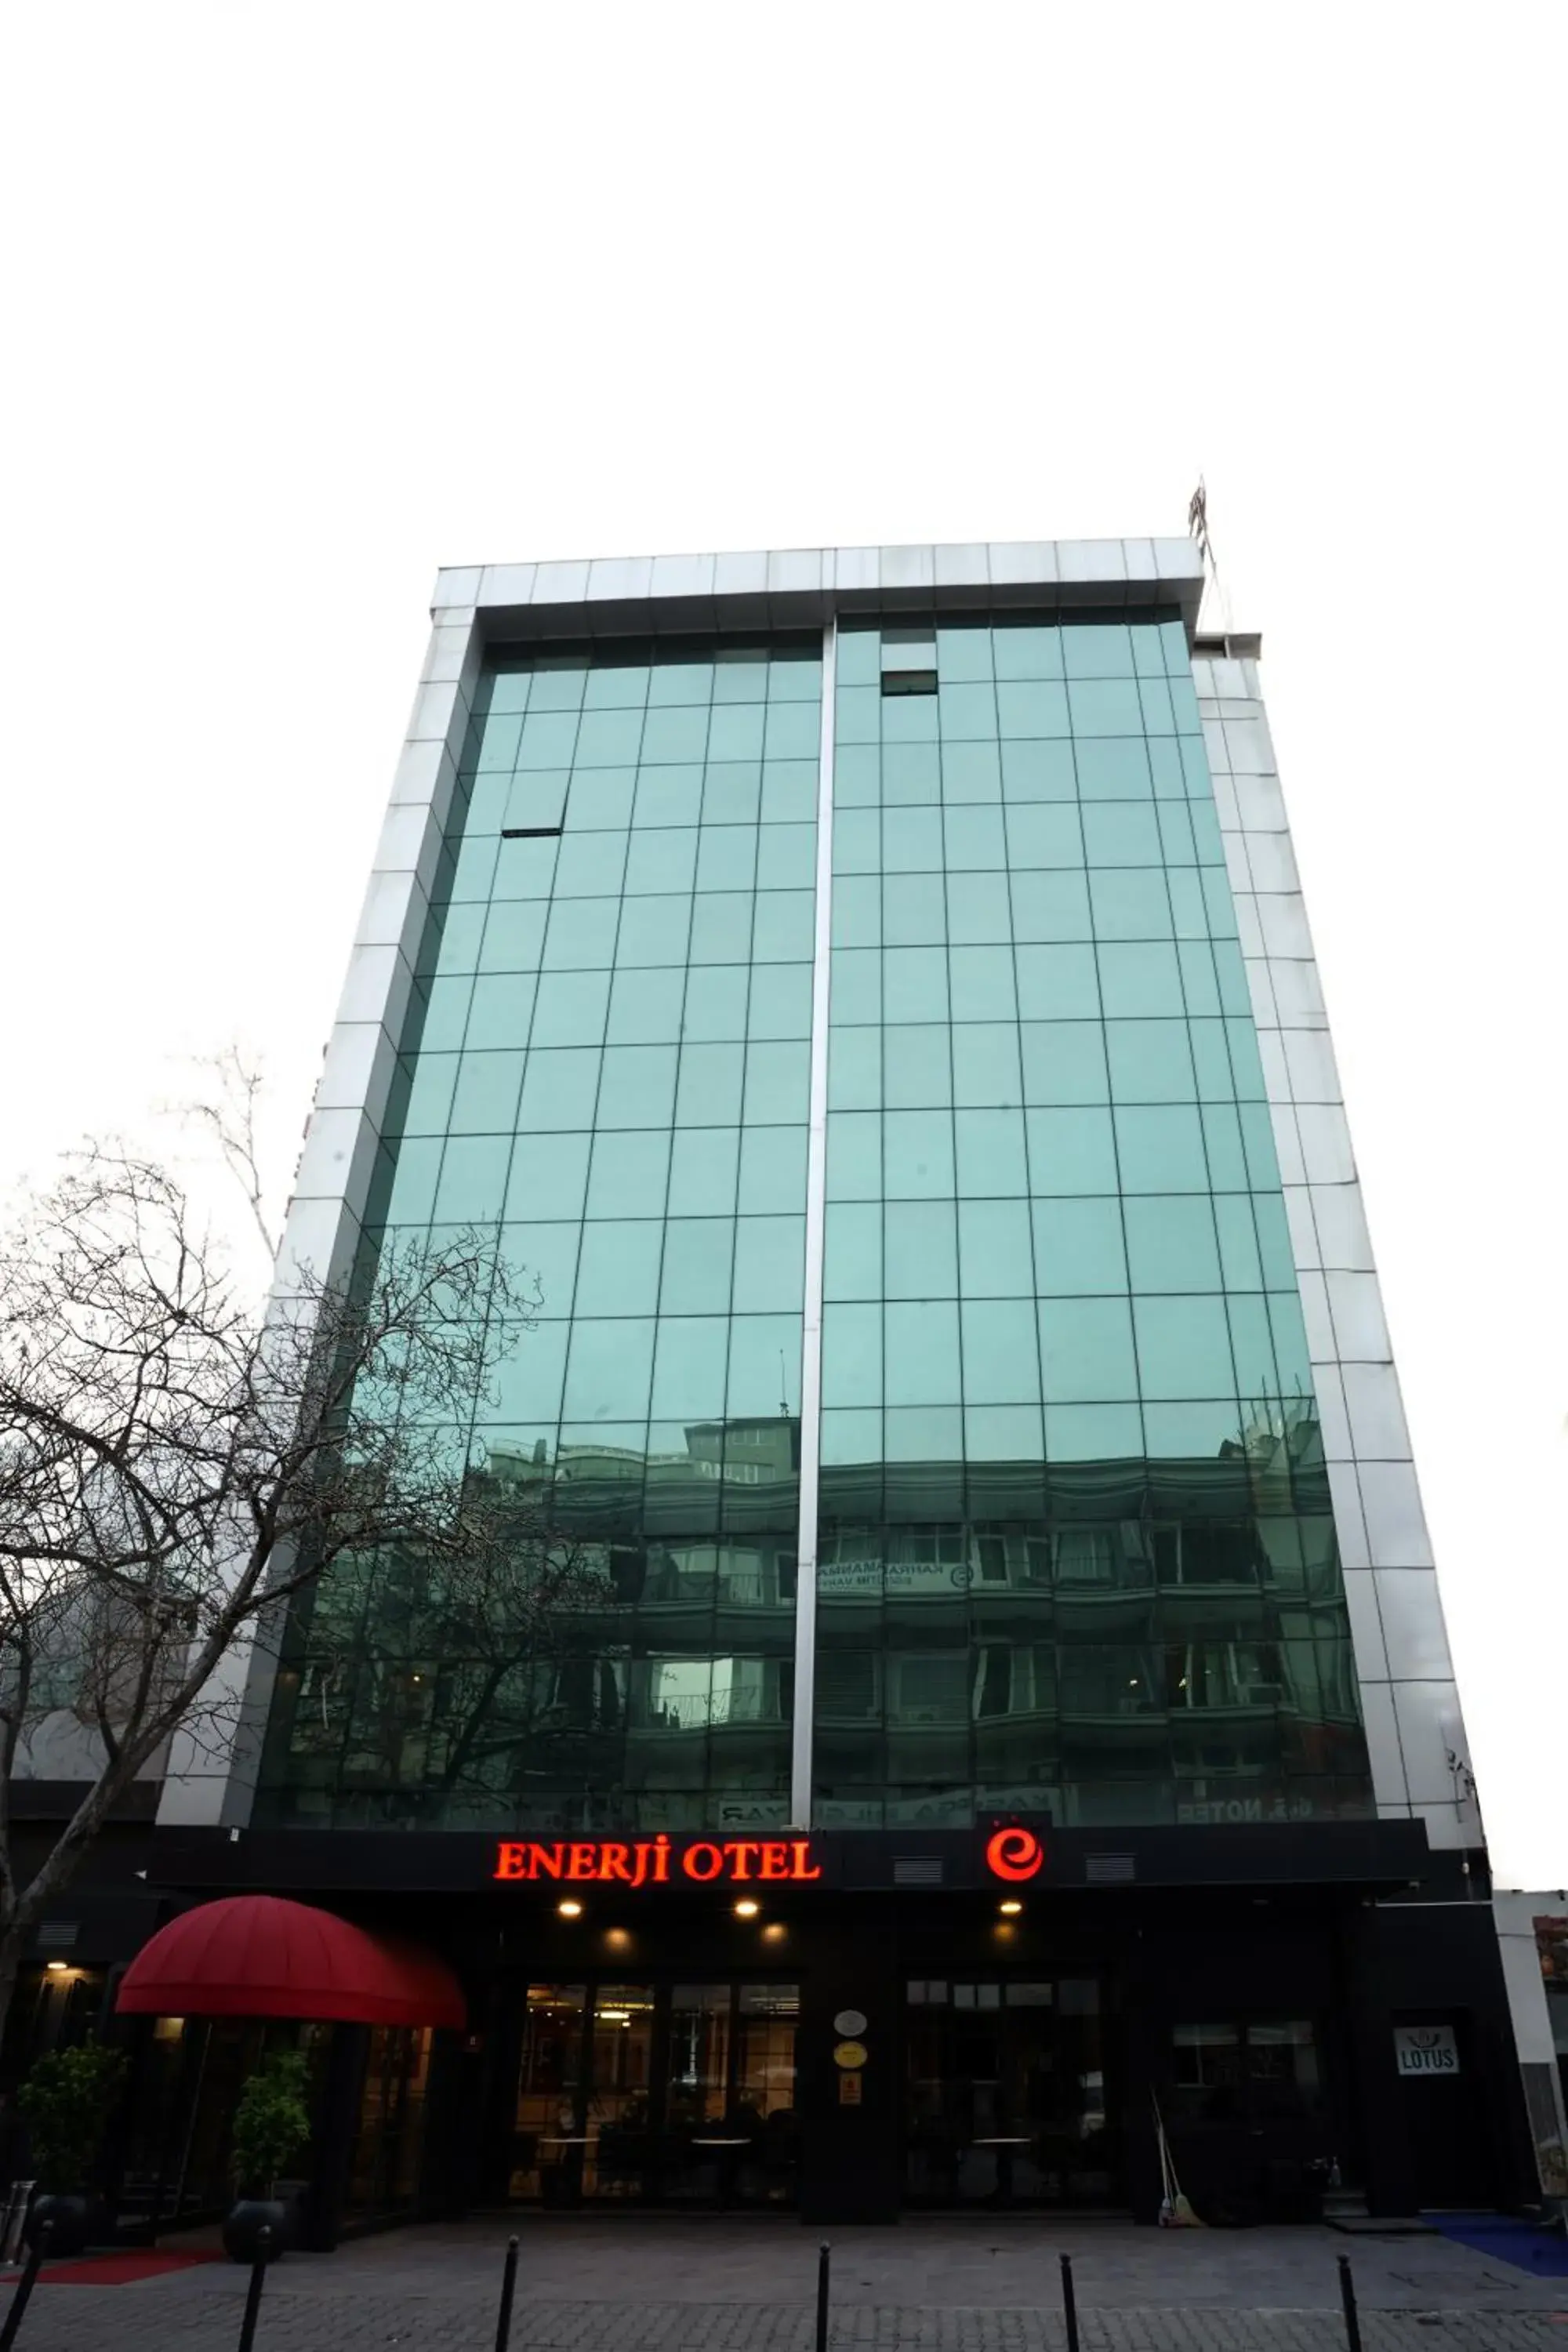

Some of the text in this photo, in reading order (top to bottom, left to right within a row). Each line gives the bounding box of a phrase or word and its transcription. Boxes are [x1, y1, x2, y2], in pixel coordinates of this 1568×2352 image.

[493, 1834, 821, 1887] ENERJİ OTEL
[1400, 2048, 1454, 2070] LOTUS
